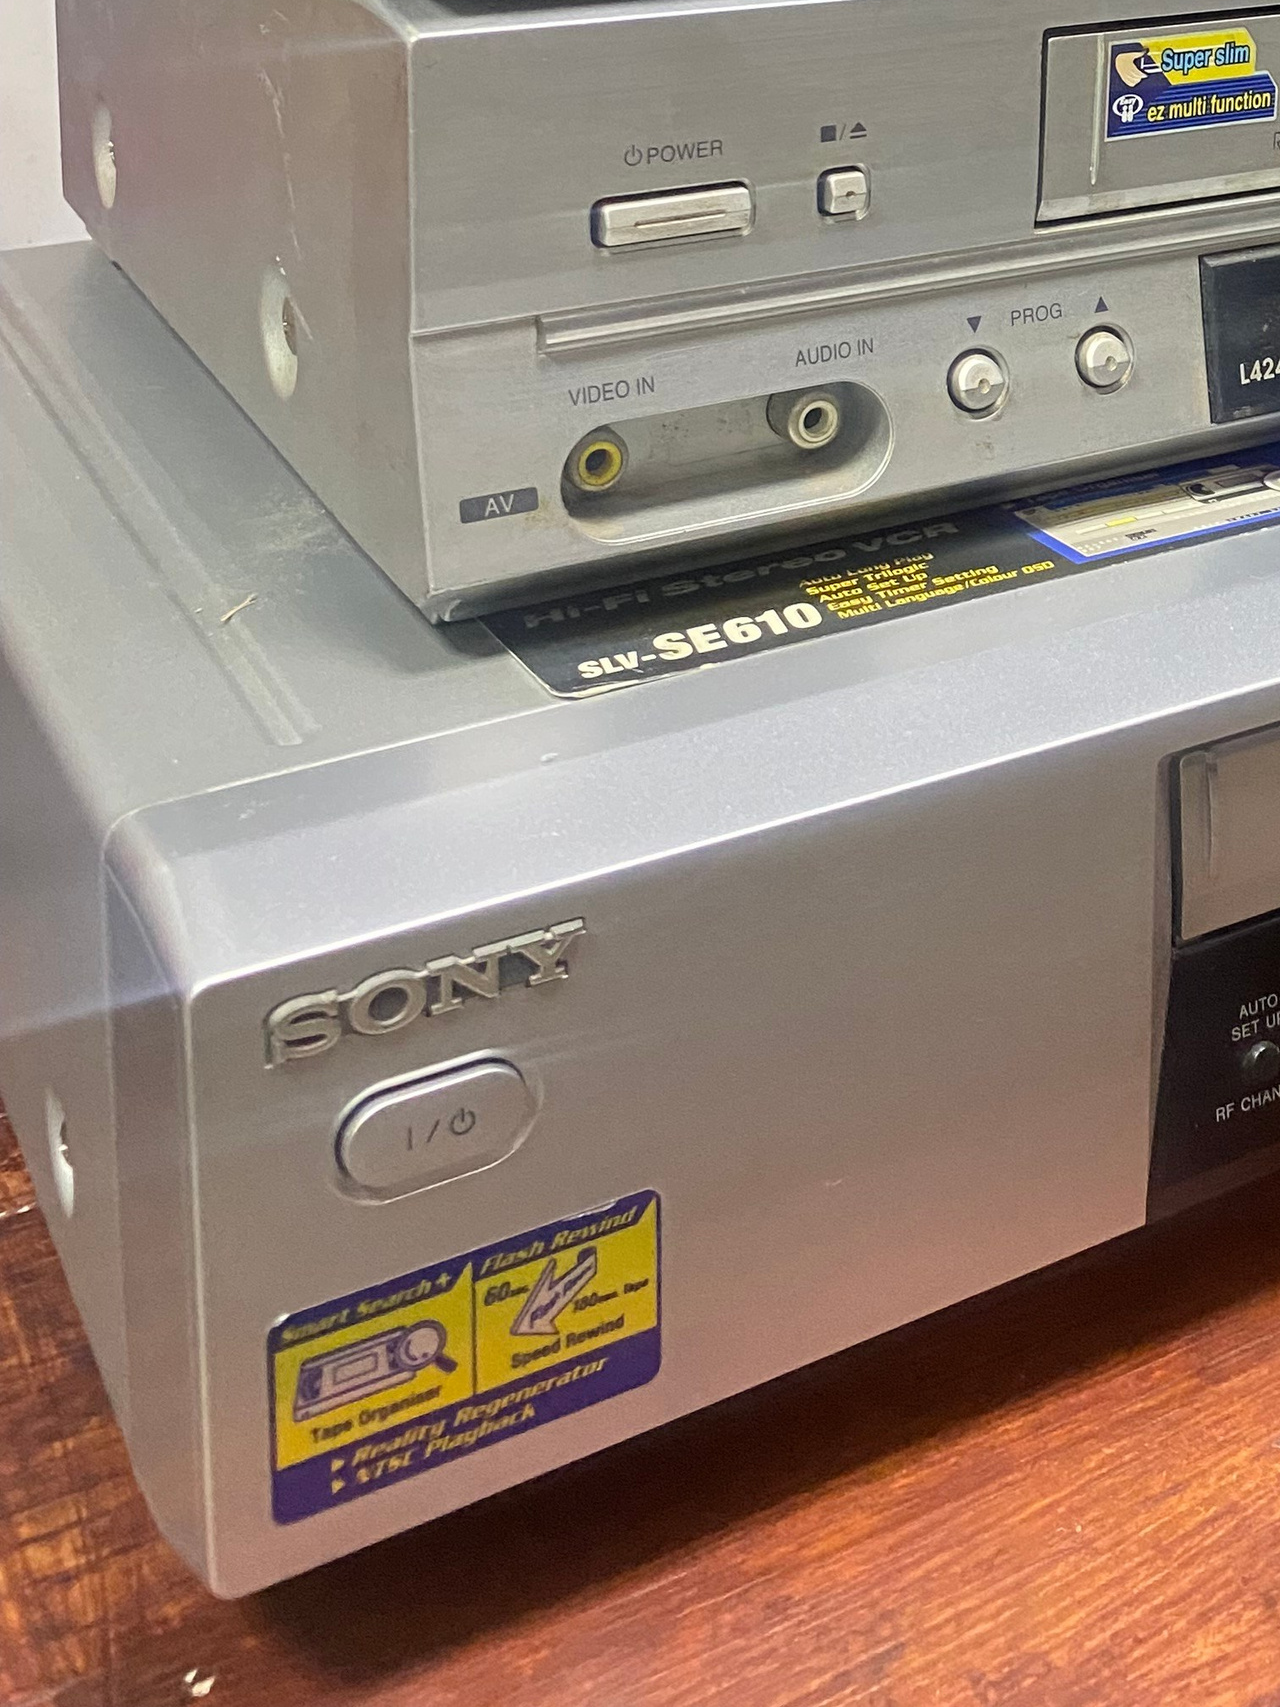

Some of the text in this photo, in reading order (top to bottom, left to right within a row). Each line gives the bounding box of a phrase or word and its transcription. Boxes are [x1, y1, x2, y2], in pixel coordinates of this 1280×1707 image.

[1160, 41, 1251, 76] Super slim
[1147, 91, 1272, 122] ez multi function
[647, 140, 724, 165] POWER
[1010, 303, 1063, 326] PROG
[794, 338, 875, 368] AUDIO IN
[568, 376, 656, 406] VIDEO IN
[484, 493, 515, 516] AV
[852, 522, 961, 553] VCR
[805, 562, 930, 596] Super Trilogic
[819, 572, 929, 603] Auto Set Up
[826, 564, 1000, 612] Easy Timer Setting
[837, 560, 1056, 620] Multi Language/Colour OSD
[576, 602, 823, 680] SLV-SE610
[262, 916, 587, 1070] SONY
[1238, 993, 1279, 1020] AUTO
[1231, 1019, 1260, 1041] SET
[1215, 1102, 1236, 1122] RF
[479, 1206, 638, 1276] Flash Rewind
[281, 1308, 351, 1342] Smart
[357, 1279, 433, 1316] Search
[511, 1313, 625, 1369] Speed Rewind
[351, 1357, 610, 1467] Reality Regenerator
[310, 1419, 353, 1443] Tape
[424, 1403, 536, 1459] Playback
